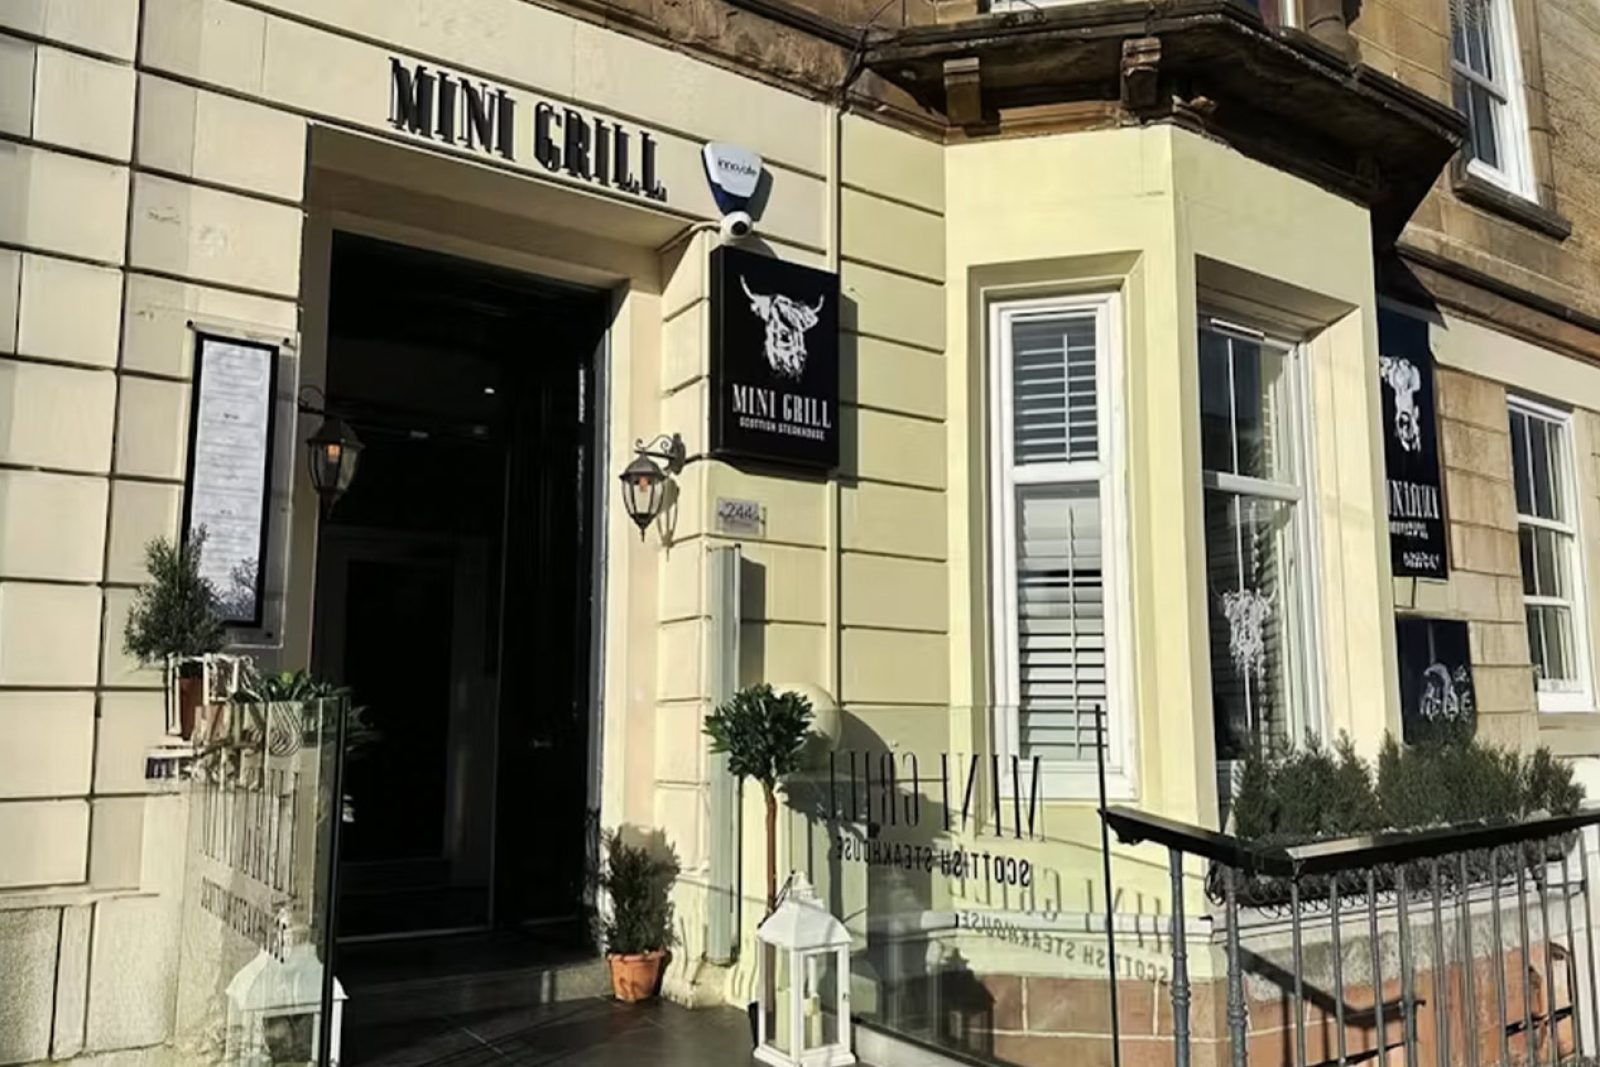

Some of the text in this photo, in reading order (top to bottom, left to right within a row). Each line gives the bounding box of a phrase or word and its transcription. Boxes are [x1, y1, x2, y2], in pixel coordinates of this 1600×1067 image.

[387, 57, 667, 203] MINI GRILL
[732, 383, 832, 429] MINI GRILL
[739, 416, 825, 441] SCOTTISH STEAKHOUSE
